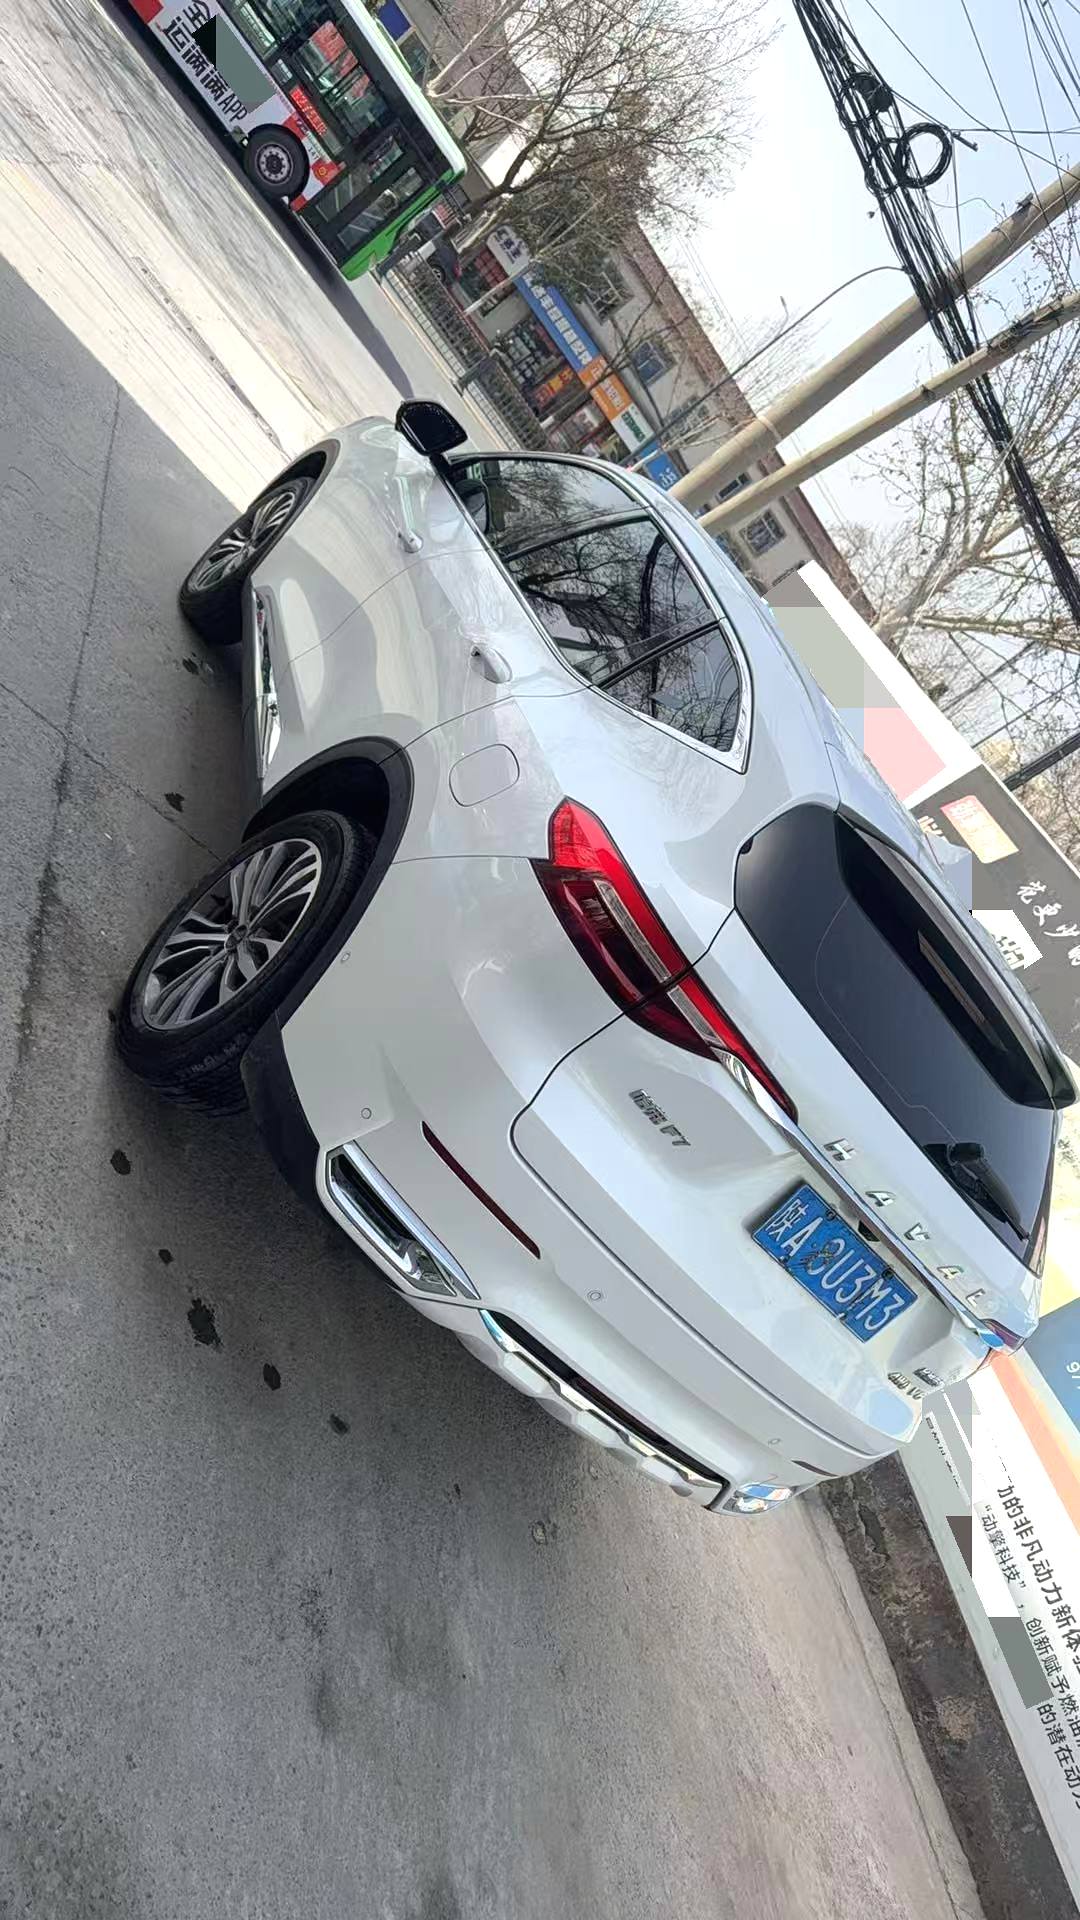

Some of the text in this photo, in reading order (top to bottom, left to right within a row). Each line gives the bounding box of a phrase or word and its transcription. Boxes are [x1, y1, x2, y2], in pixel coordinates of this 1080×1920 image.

[823, 1137, 986, 1308] HAVAL
[1036, 1702, 1080, 1810] 的潜在动
